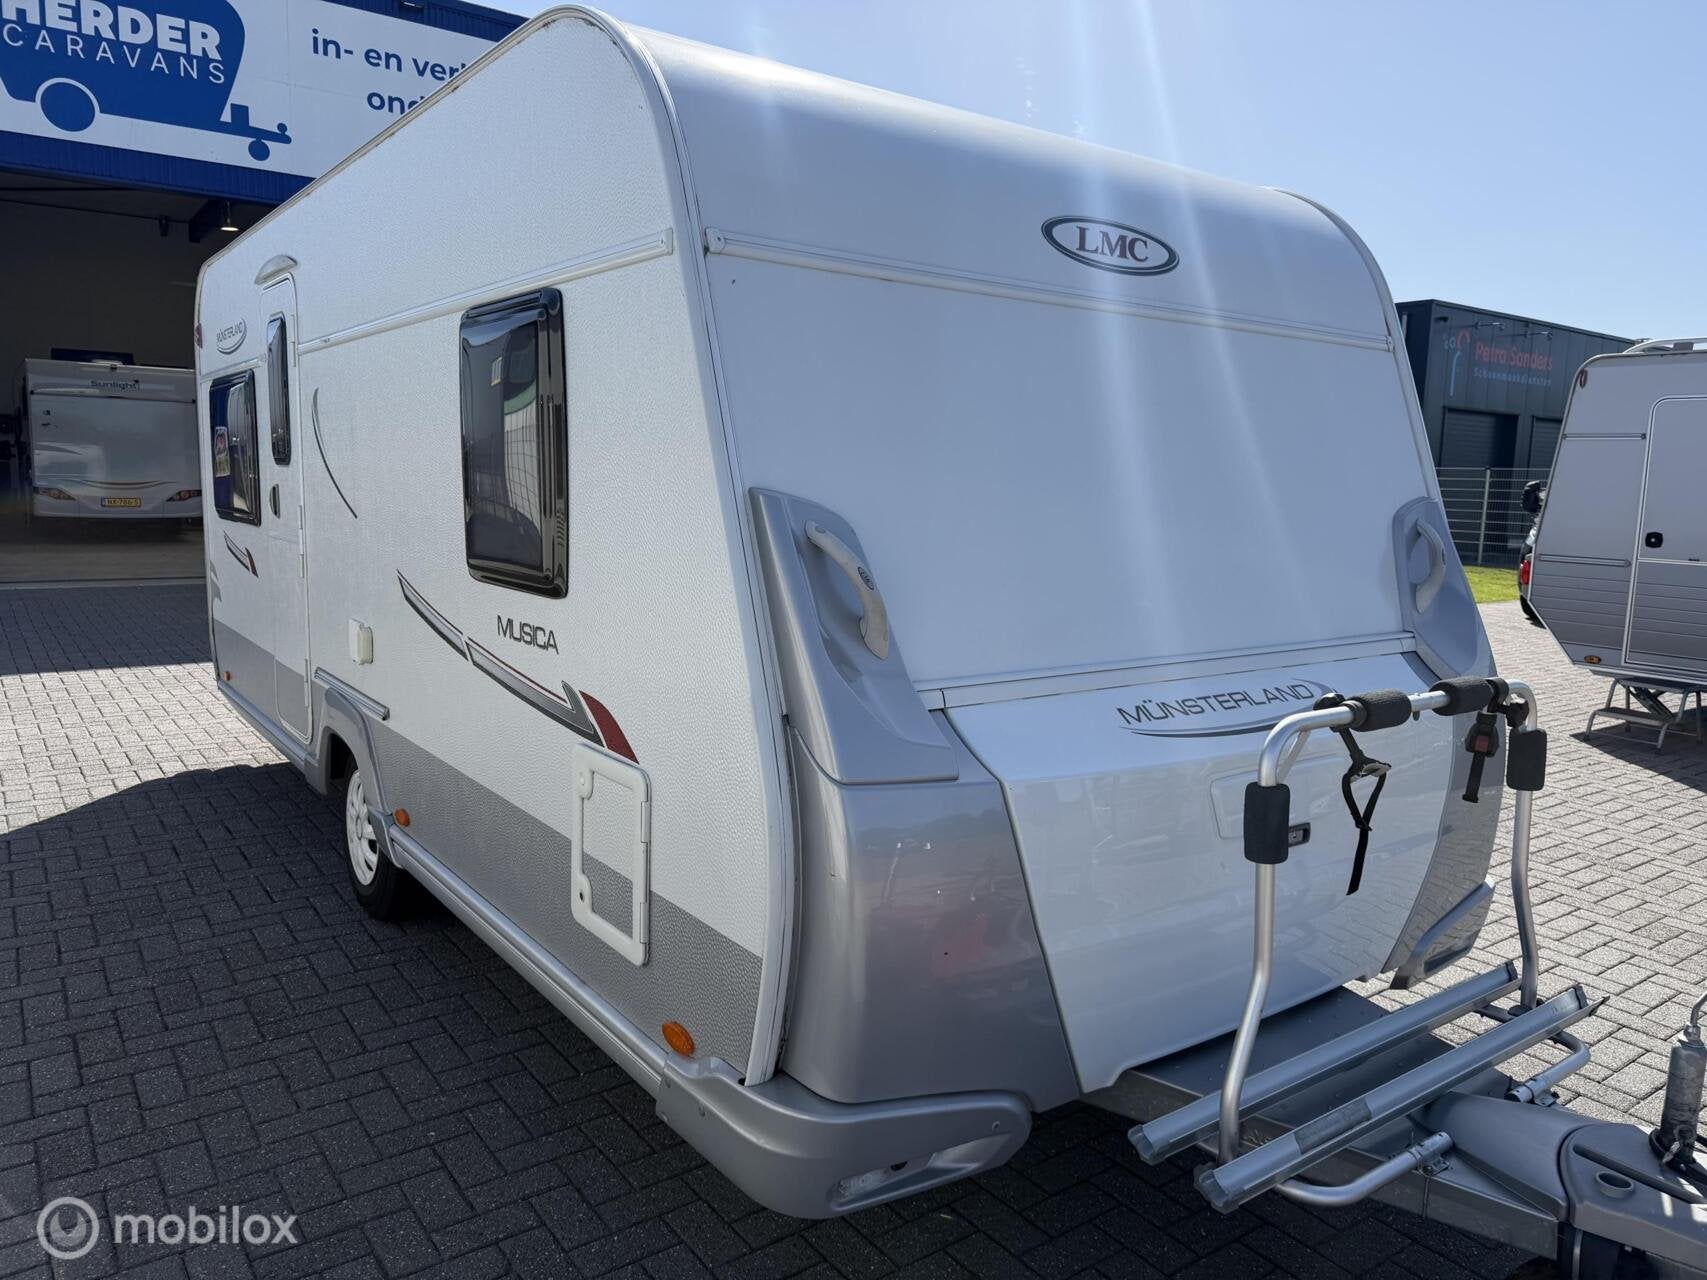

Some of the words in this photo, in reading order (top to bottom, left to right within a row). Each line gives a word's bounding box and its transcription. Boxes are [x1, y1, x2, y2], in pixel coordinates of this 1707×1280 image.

[1, 0, 222, 60] HERDER
[3, 24, 225, 84] CARAVANS
[312, 28, 353, 59] in-
[364, 48, 403, 72] en
[412, 57, 466, 81] ver
[1075, 225, 1149, 262] LMC
[90, 380, 139, 391] Sunlight
[497, 614, 559, 655] MUSICA
[1116, 684, 1315, 725] MÜNSTERLAND
